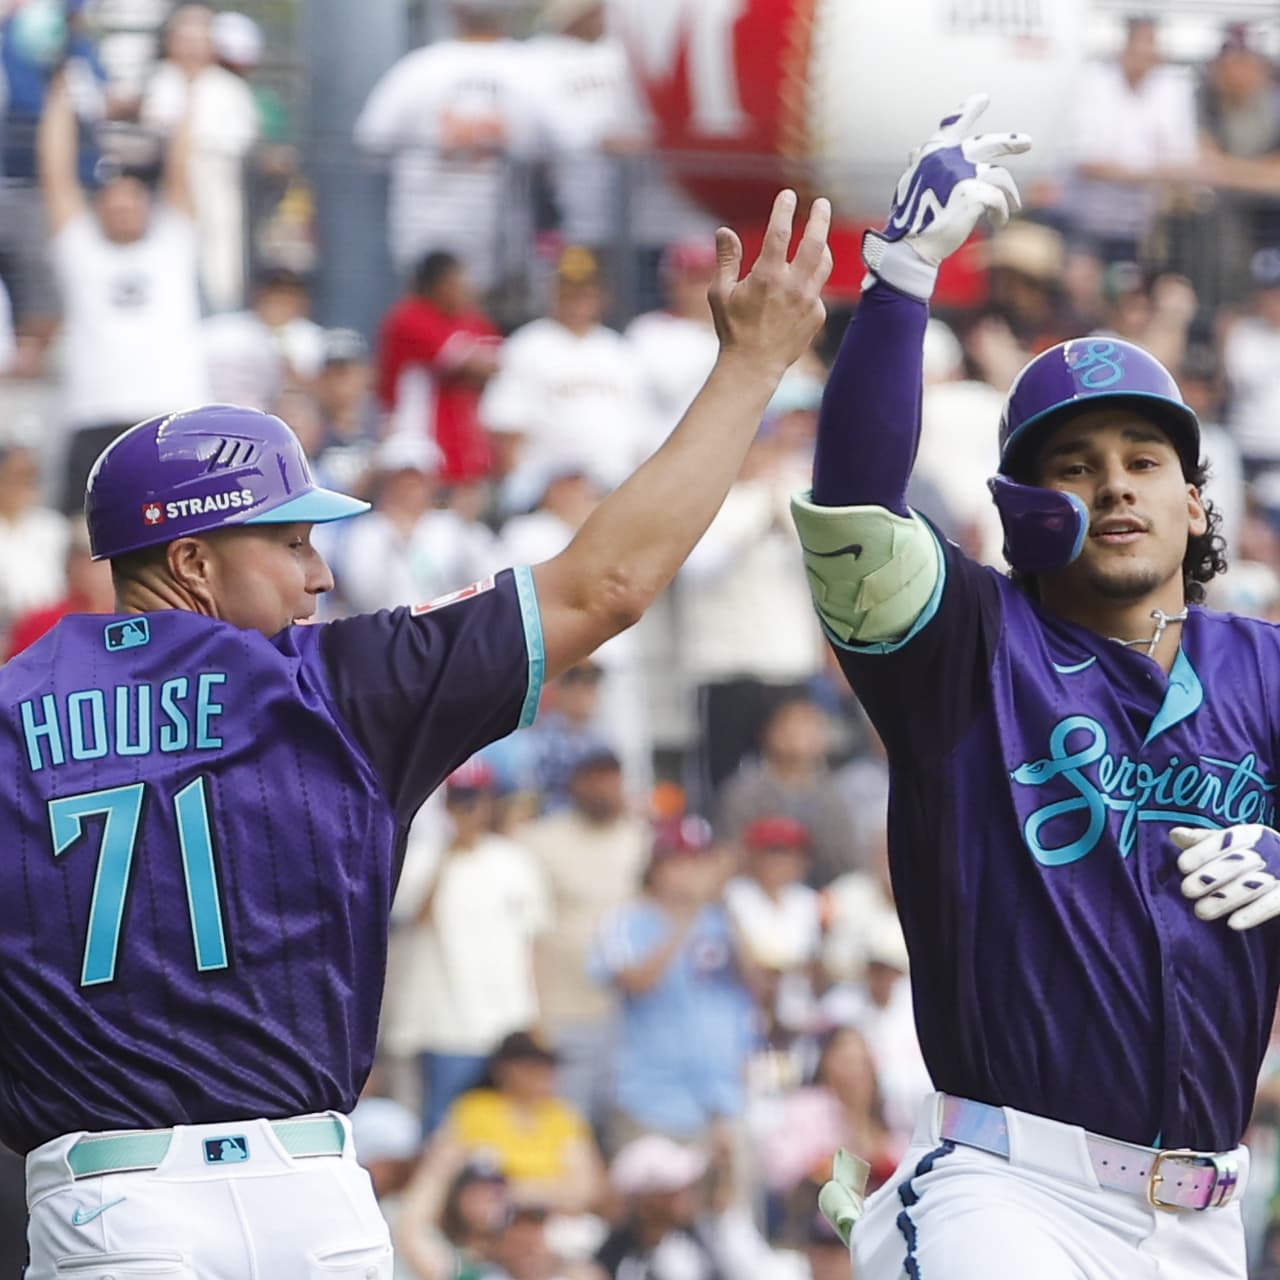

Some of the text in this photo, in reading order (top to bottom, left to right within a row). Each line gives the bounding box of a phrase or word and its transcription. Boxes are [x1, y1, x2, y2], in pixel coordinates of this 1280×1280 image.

[166, 489, 253, 518] STRAUSS
[21, 673, 227, 771] HOUSE
[47, 775, 229, 987] 71
